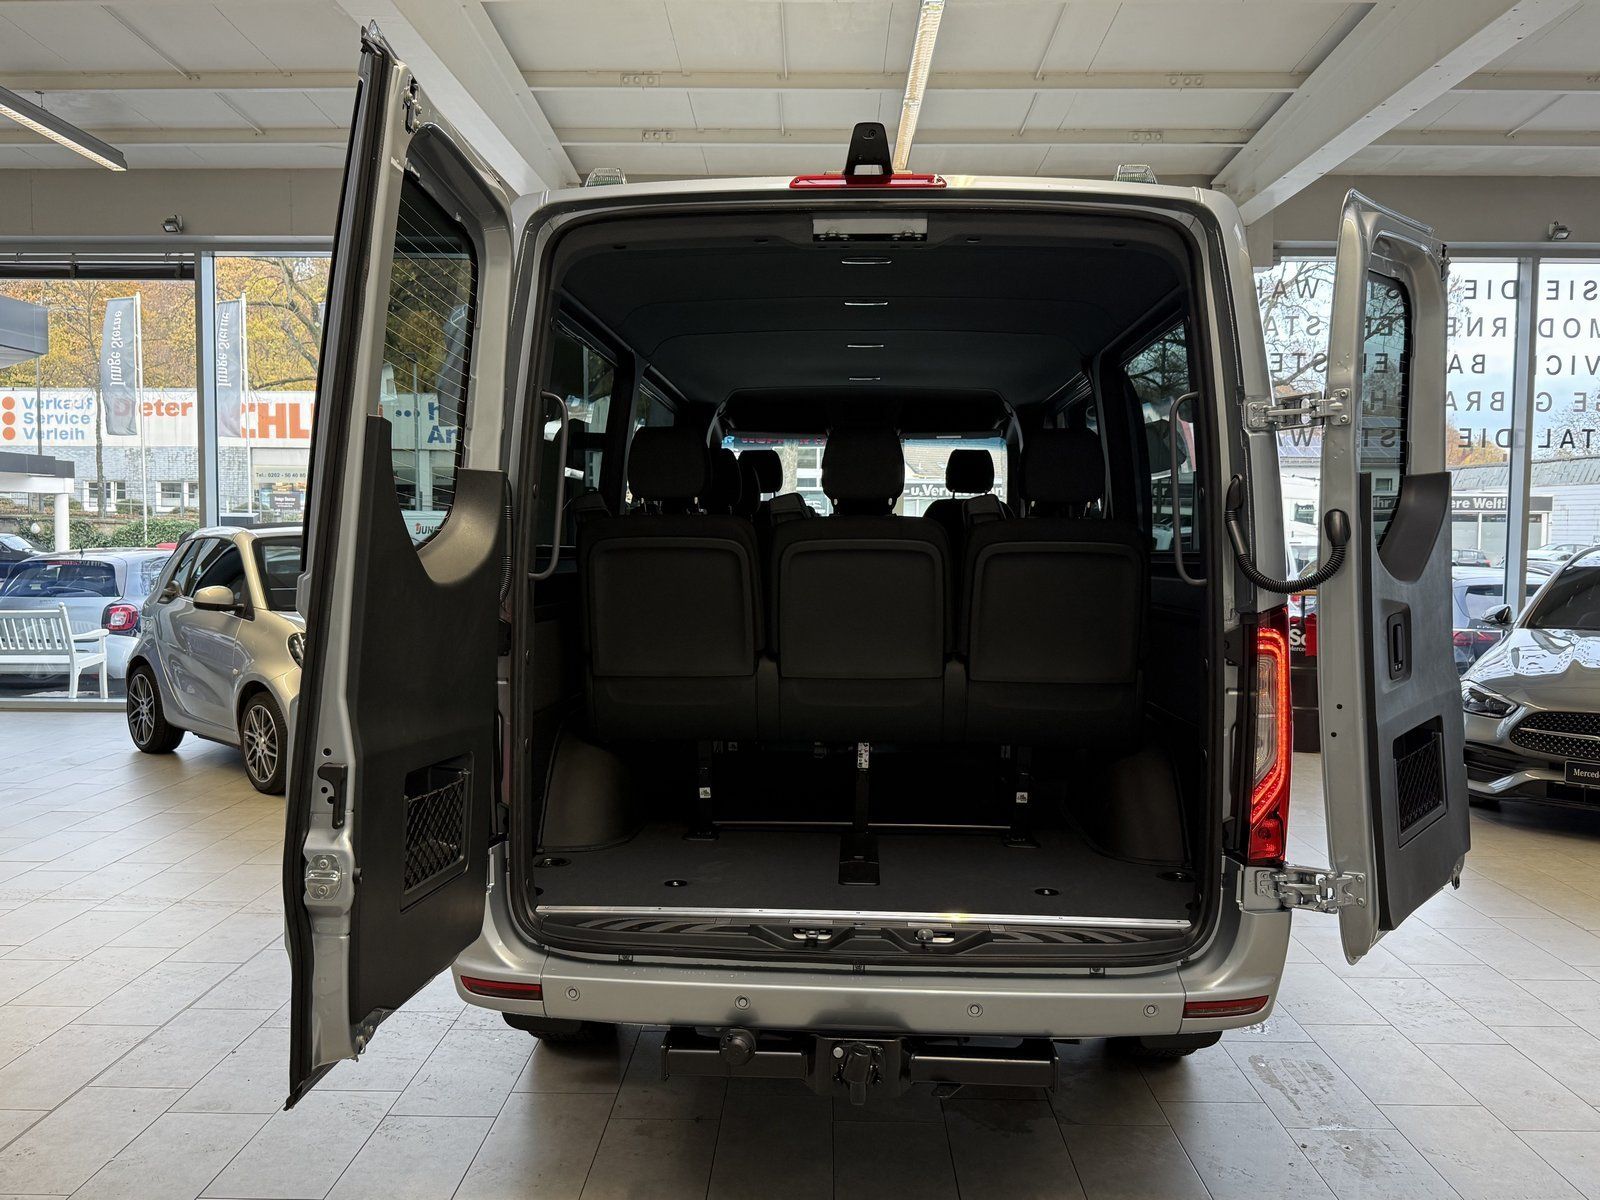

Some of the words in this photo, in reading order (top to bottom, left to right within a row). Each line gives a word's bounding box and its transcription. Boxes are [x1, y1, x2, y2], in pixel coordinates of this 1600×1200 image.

[22, 397, 93, 410] Verkauf
[23, 412, 91, 425] Service
[22, 427, 85, 441] Verleih
[1473, 497, 1507, 509] Welt!
[1573, 768, 1600, 779] Merced
